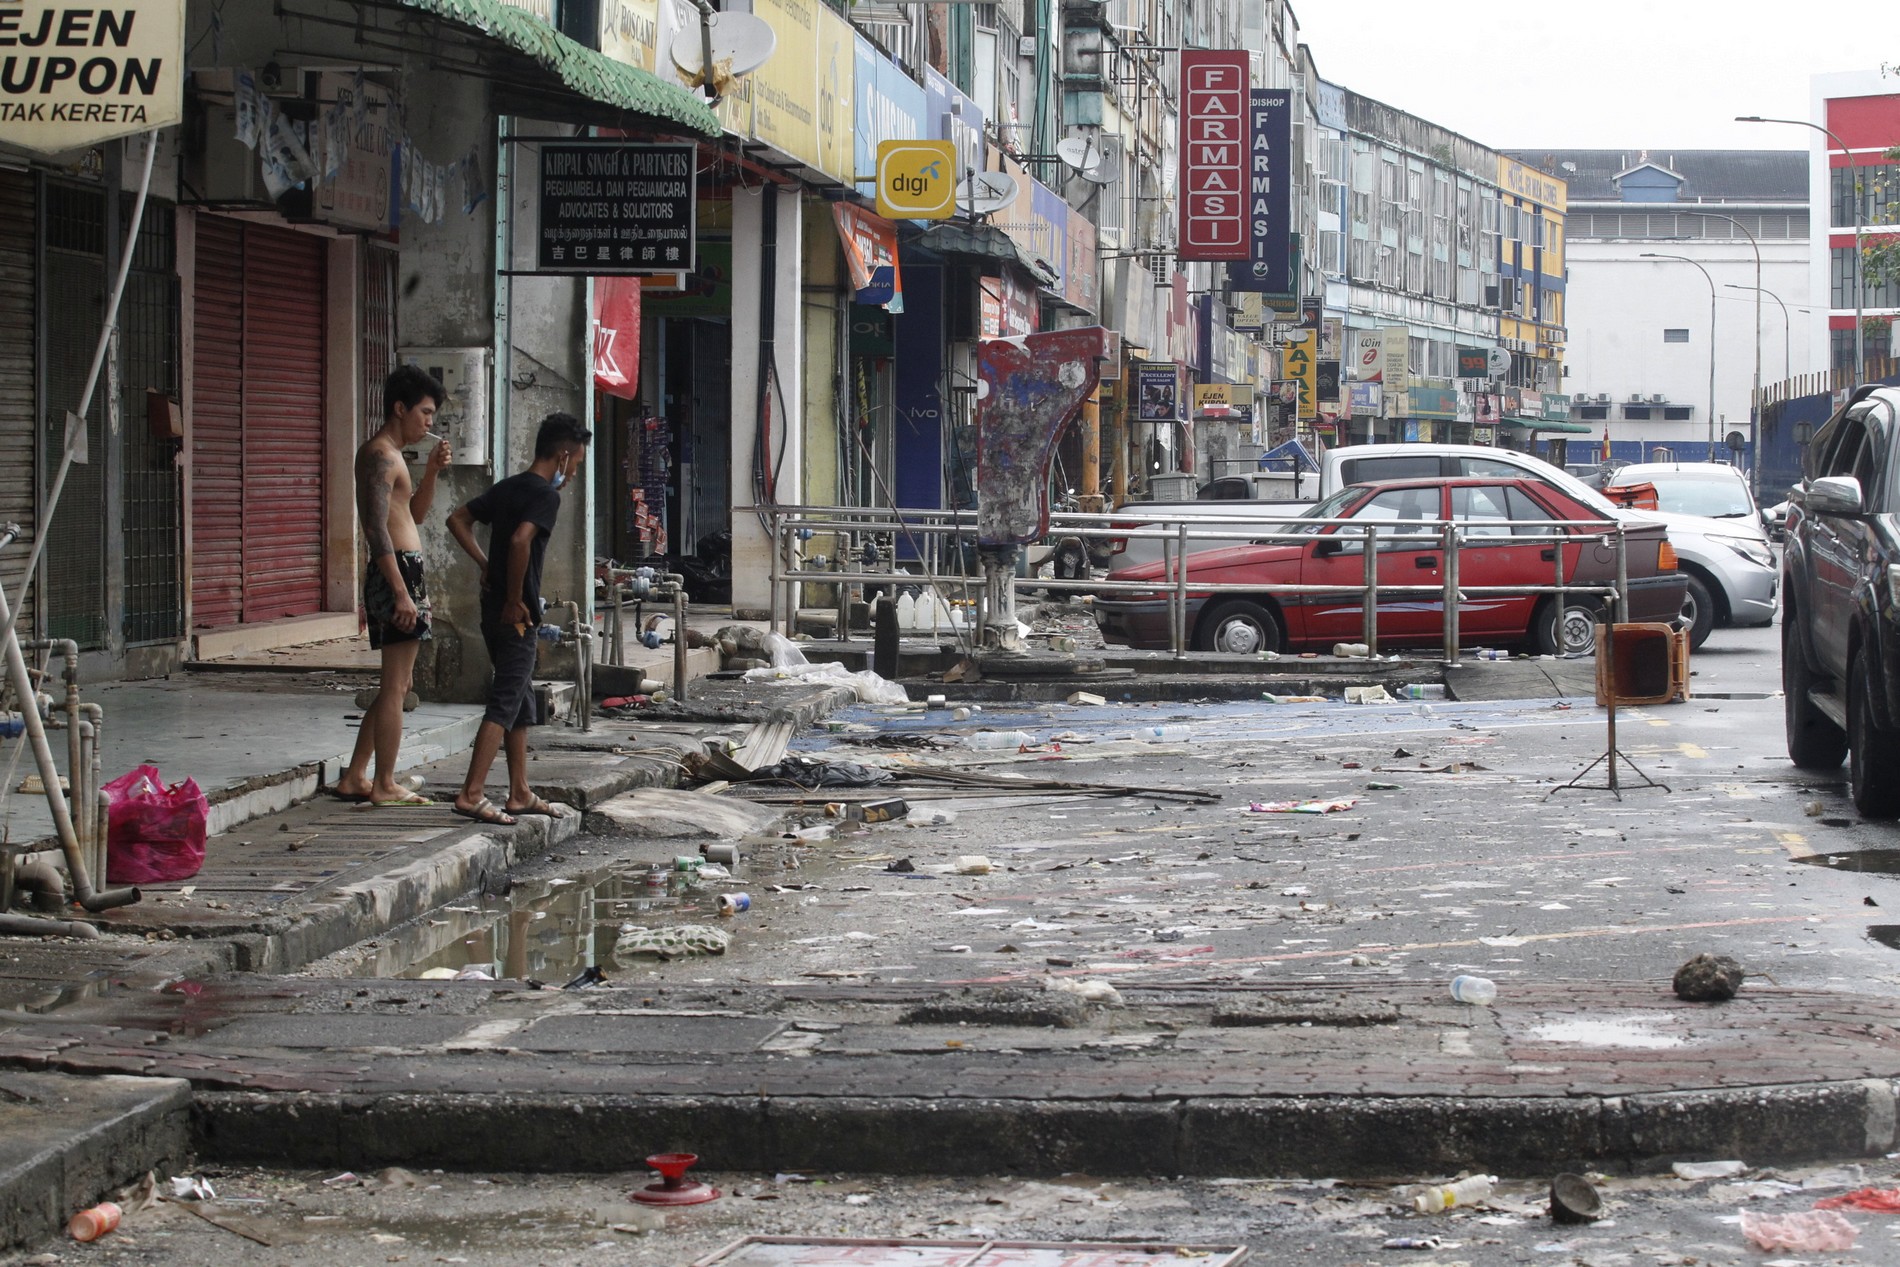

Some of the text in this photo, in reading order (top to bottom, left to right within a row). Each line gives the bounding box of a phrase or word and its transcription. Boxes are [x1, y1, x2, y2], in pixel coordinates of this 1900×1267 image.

[0, 9, 136, 47] EJEN
[0, 56, 162, 95] UPON
[1250, 98, 1285, 107] EDISHOP
[51, 103, 147, 122] KERETA
[1202, 70, 1228, 240] FARMASI
[545, 153, 688, 176] KIRPAL SINGH & PARTNERS
[545, 181, 687, 197] PEGUAMBELA DAN PEGUAMCARA
[892, 173, 928, 196] digi
[1252, 112, 1270, 258] FARMASI
[559, 202, 674, 219] ADVOCATES & SOLICITORS
[552, 245, 680, 261] 吉巴星律師樓
[1361, 338, 1381, 347] Win
[1461, 357, 1485, 369] 99
[1203, 392, 1224, 400] EJEN
